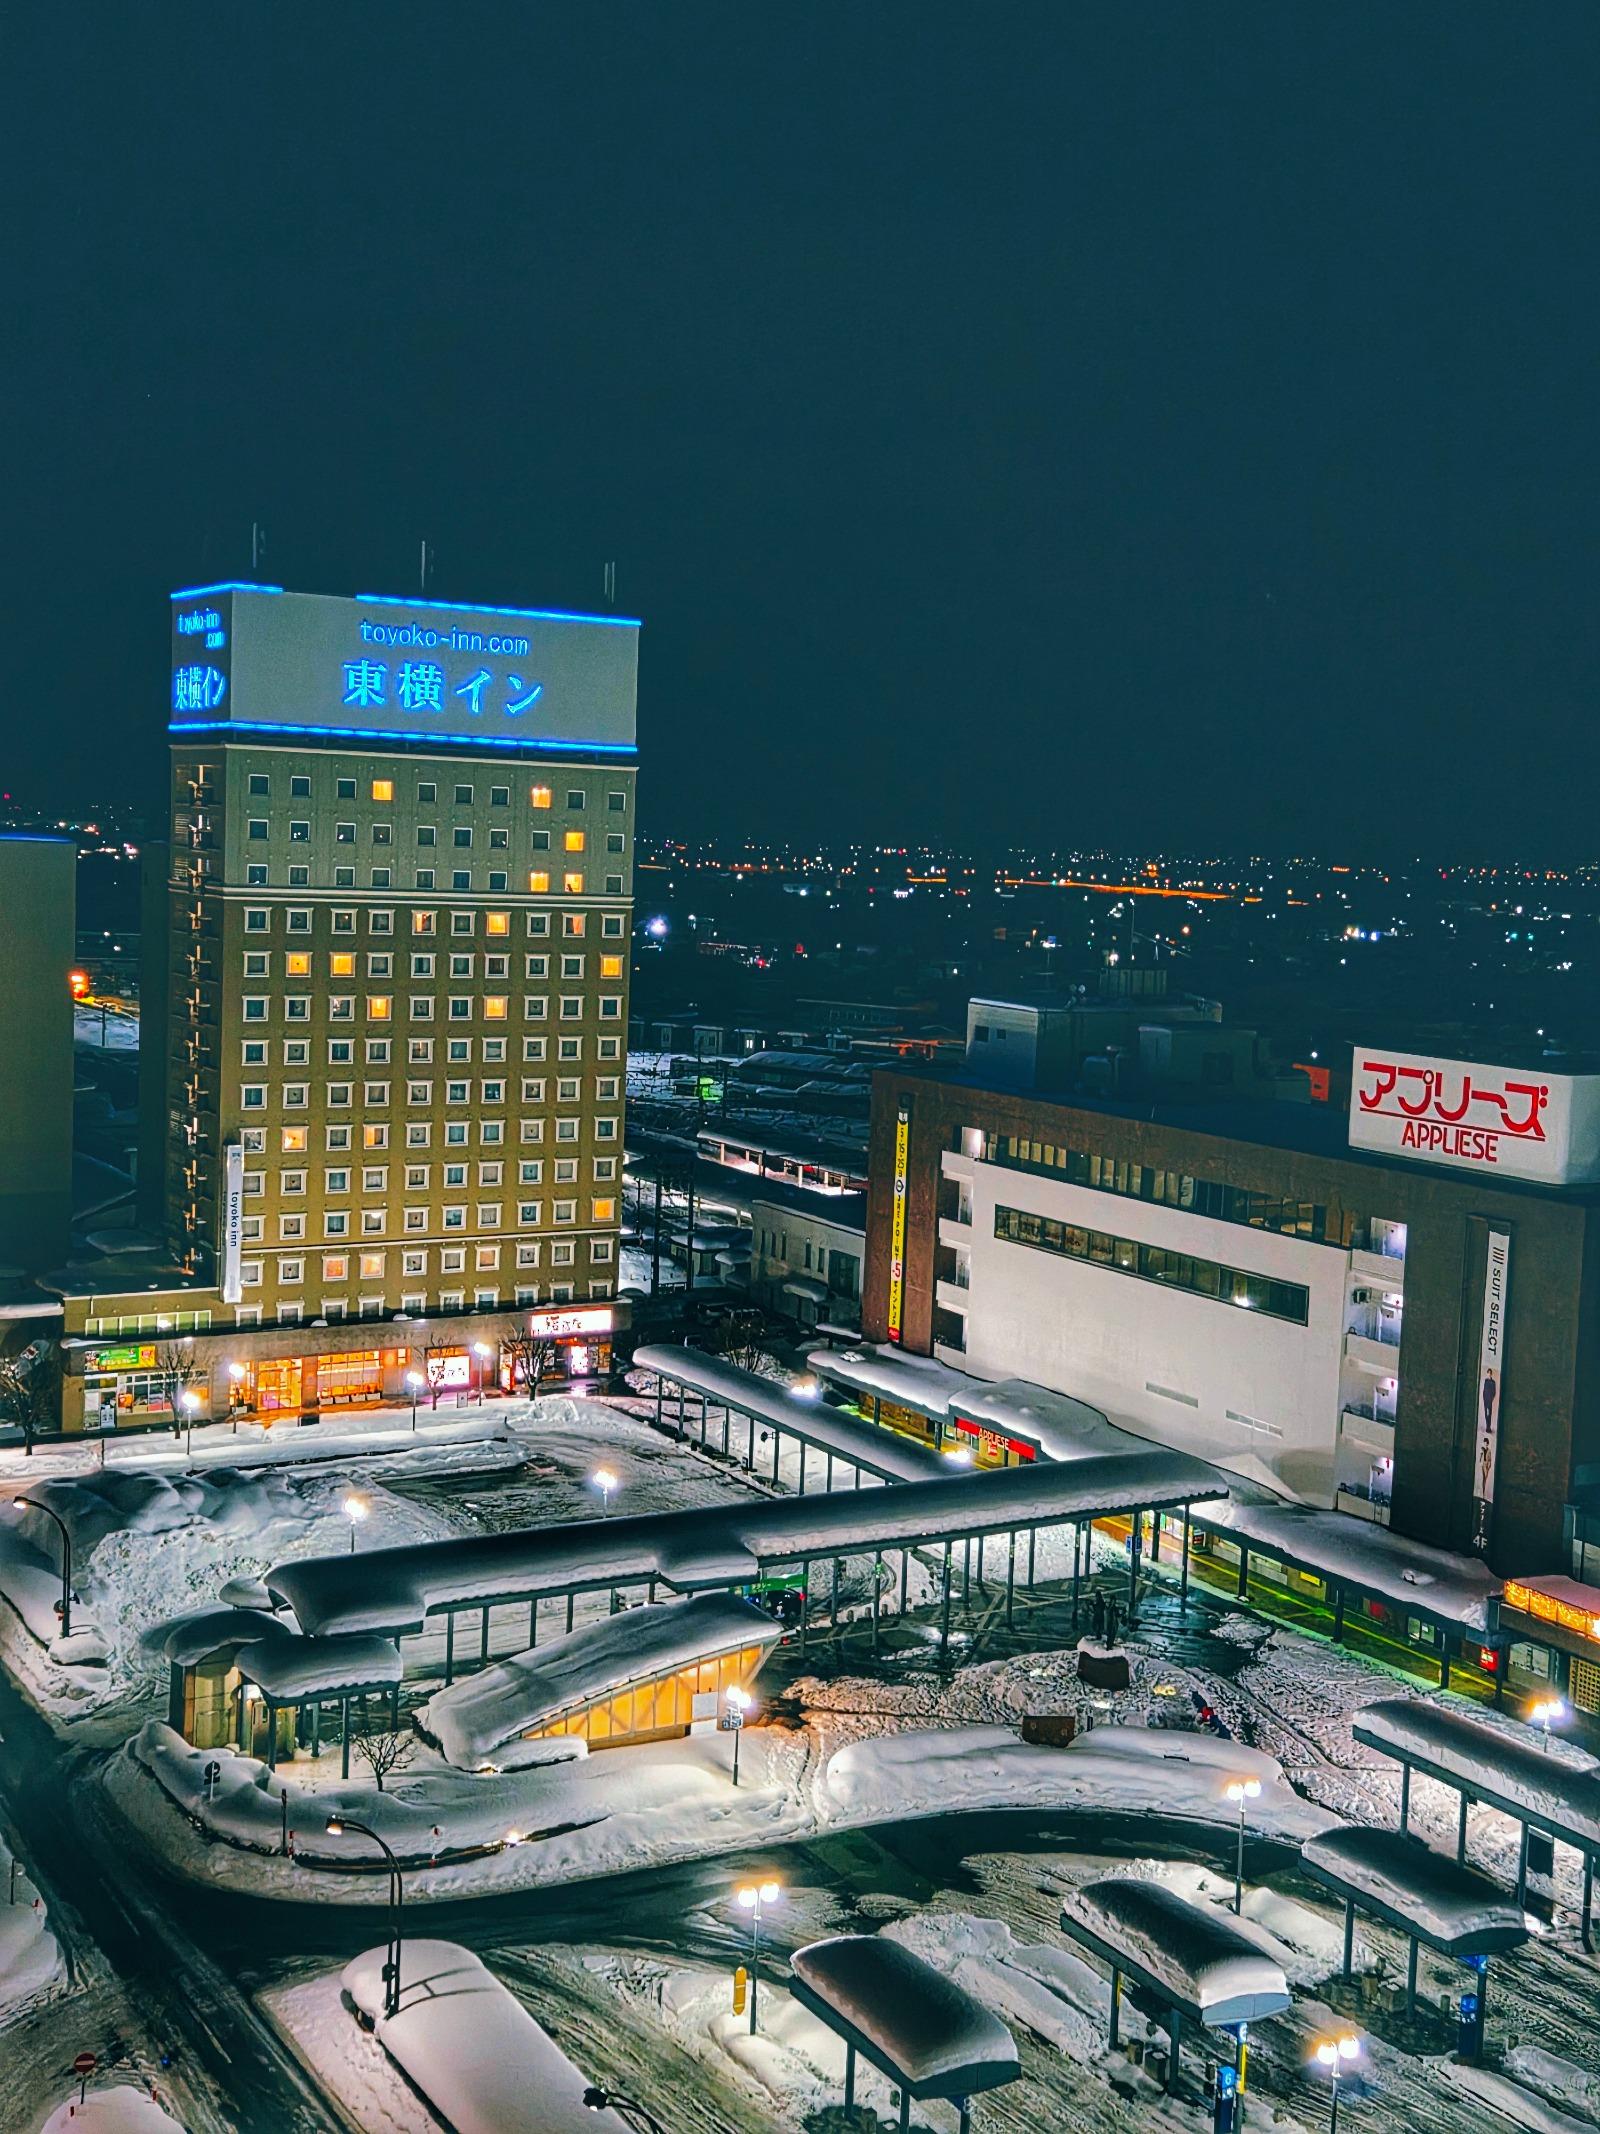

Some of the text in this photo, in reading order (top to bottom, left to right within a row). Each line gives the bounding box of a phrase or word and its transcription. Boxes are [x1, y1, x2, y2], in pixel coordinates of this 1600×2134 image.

[361, 621, 528, 655] toyoko-inn.com
[176, 666, 225, 709] 東横イン
[344, 660, 541, 714] 東横イン
[1359, 1062, 1549, 1137] アプリーズ
[1401, 1121, 1498, 1162] APPLIESE
[230, 1191, 239, 1247] toyoko inn
[1488, 1267, 1501, 1355] SUIT SELECT
[978, 1427, 1009, 1451] APPLIESE
[1473, 1534, 1488, 1549] 4F
